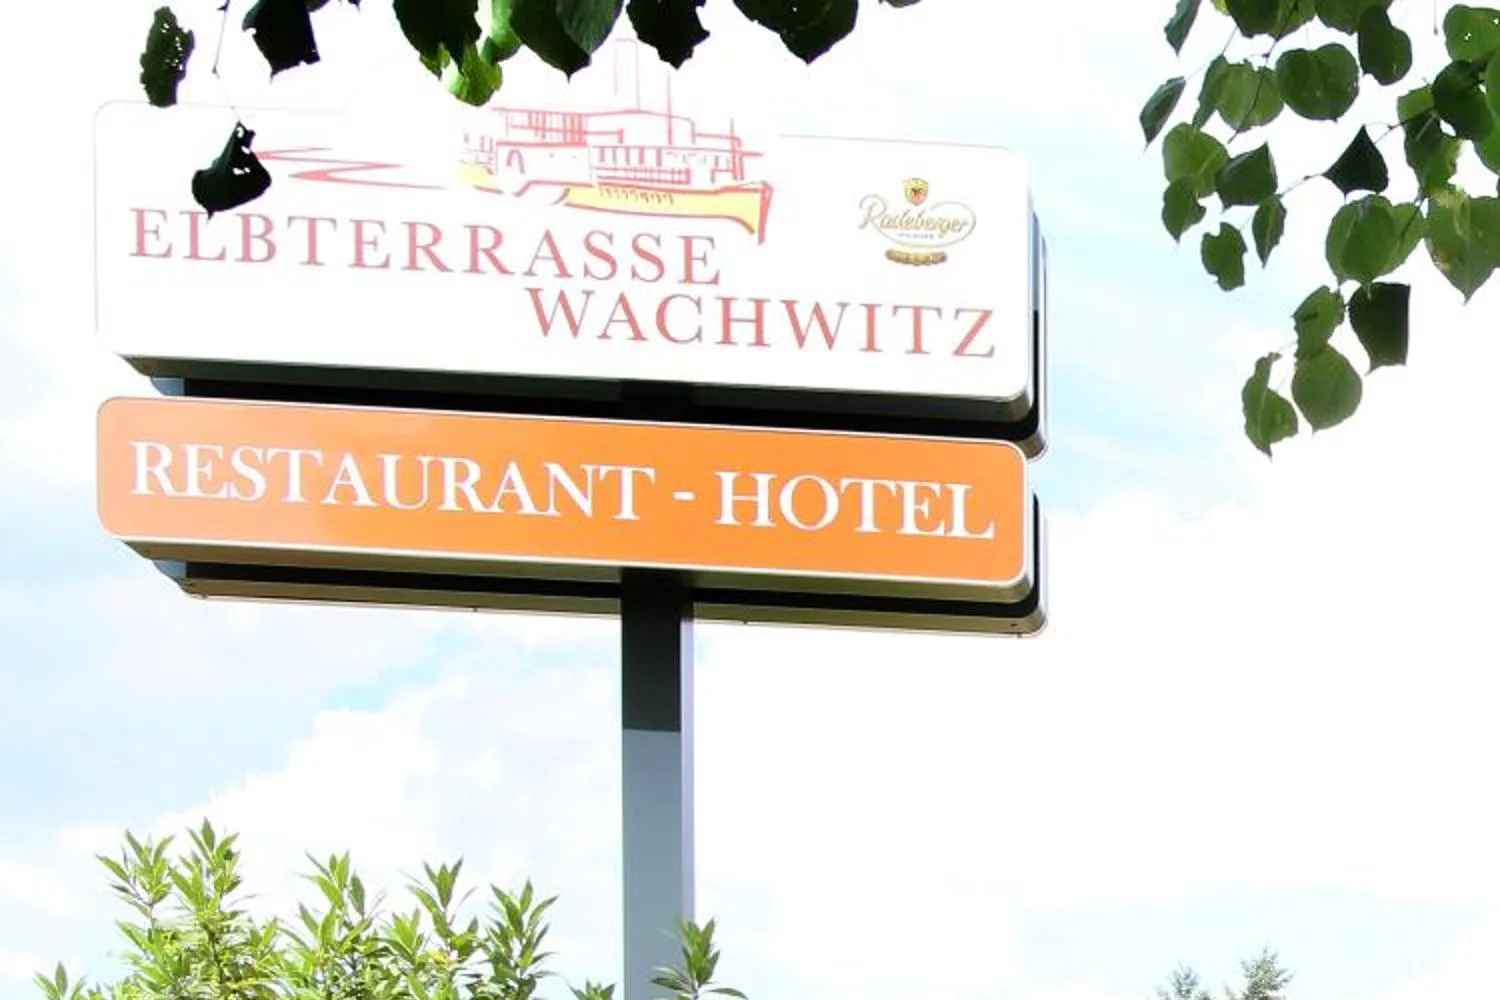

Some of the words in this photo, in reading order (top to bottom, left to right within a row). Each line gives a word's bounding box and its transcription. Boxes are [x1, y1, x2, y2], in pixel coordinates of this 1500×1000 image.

[129, 207, 720, 285] ELBTERRASSE
[524, 287, 997, 359] WACHWITZ
[129, 440, 656, 521] RESTAURANT
[715, 471, 996, 540] HOTEL
